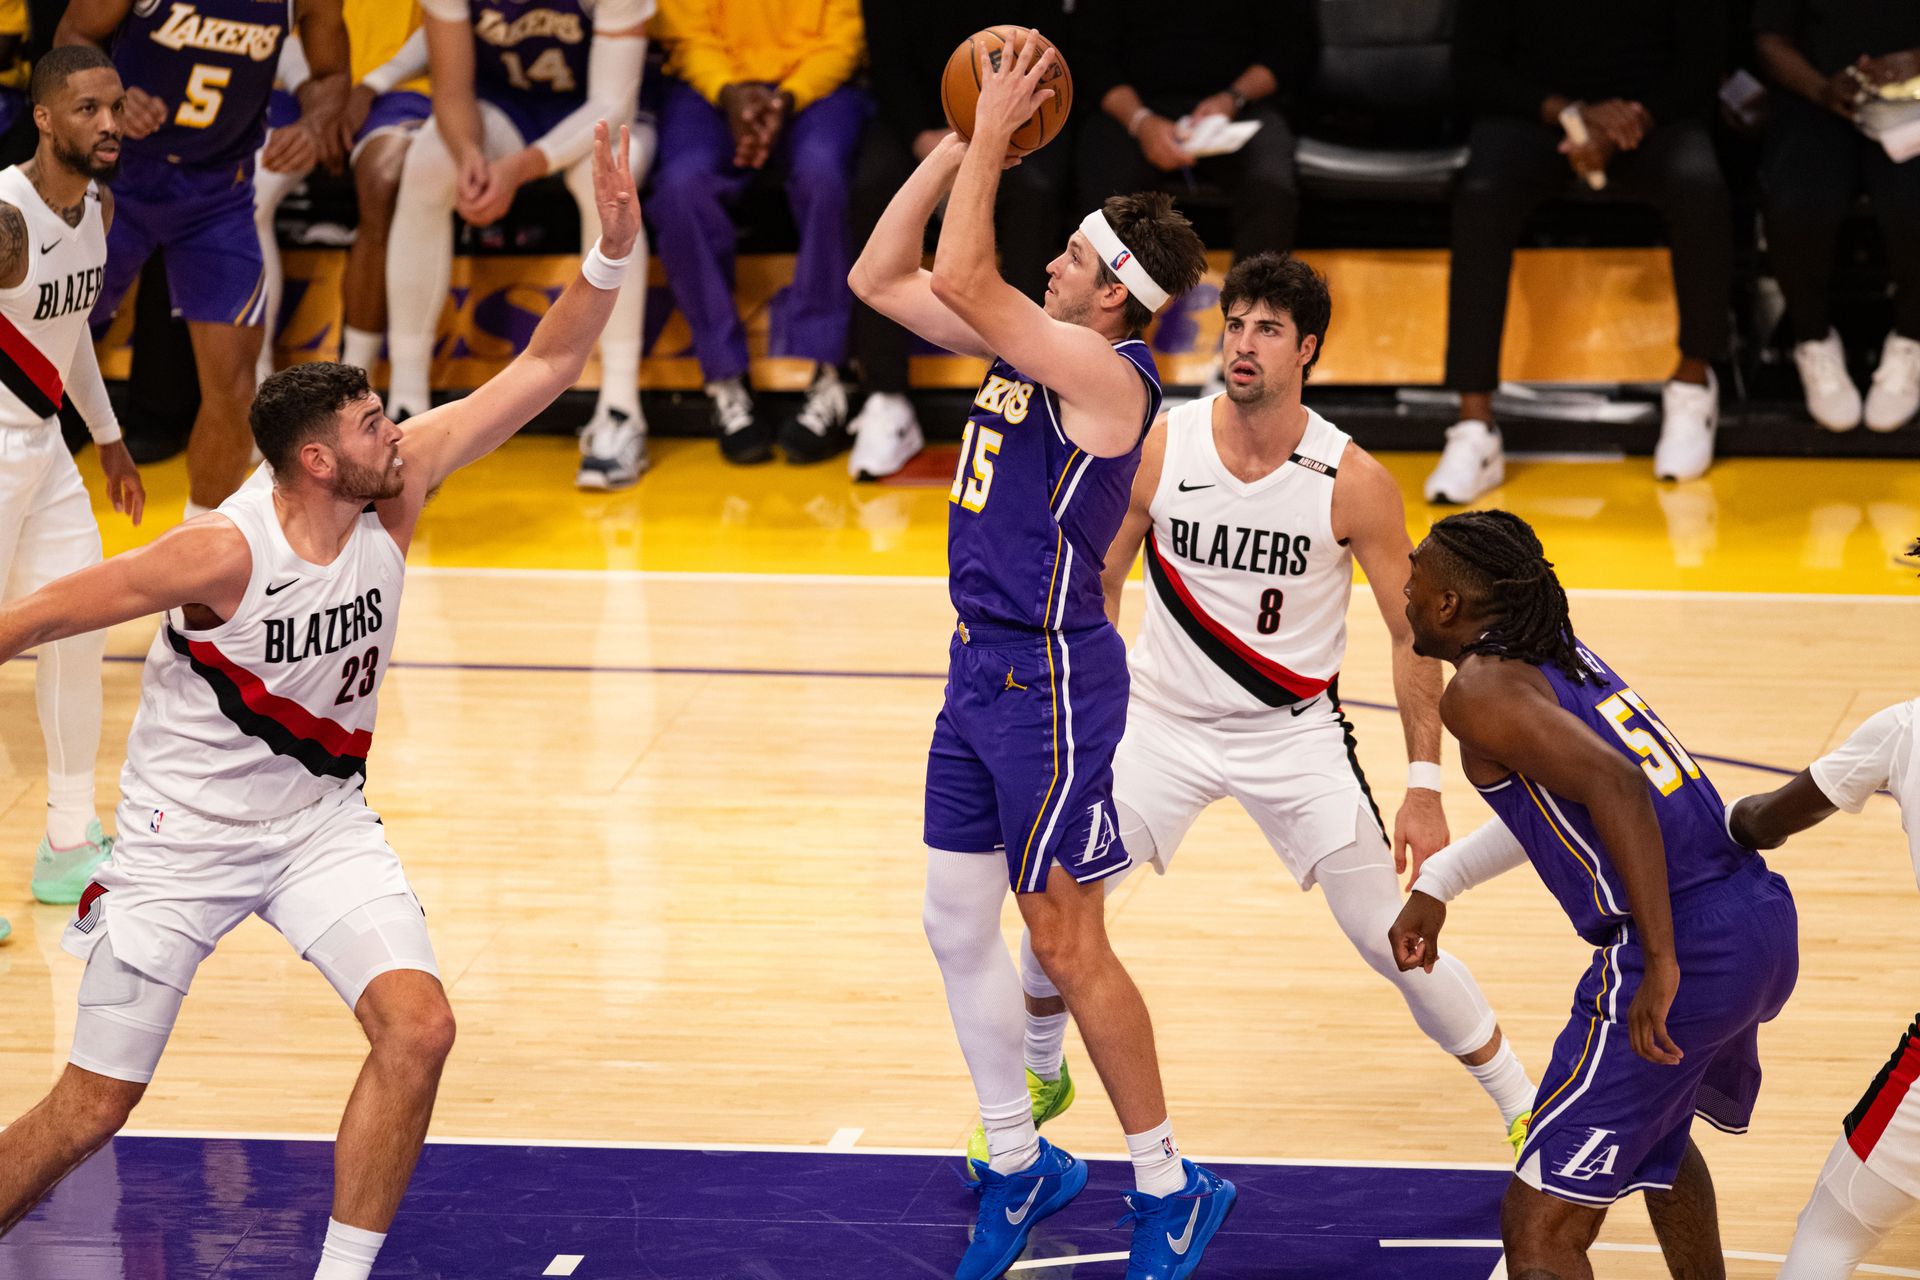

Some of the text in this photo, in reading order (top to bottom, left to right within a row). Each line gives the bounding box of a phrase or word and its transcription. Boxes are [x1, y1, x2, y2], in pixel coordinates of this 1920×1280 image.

[150, 2, 281, 61] LAKERS
[174, 63, 232, 129] 5
[501, 48, 576, 92] 14
[33, 264, 106, 320] BLAZER
[948, 420, 1004, 514] 15
[1168, 517, 1312, 576] BLAZERS
[261, 588, 383, 664] BLAZERS
[1256, 587, 1284, 635] 8
[333, 645, 380, 707] 23
[1594, 687, 1701, 798] 55
[1071, 799, 1117, 867] LA
[1550, 1126, 1620, 1181] LA
